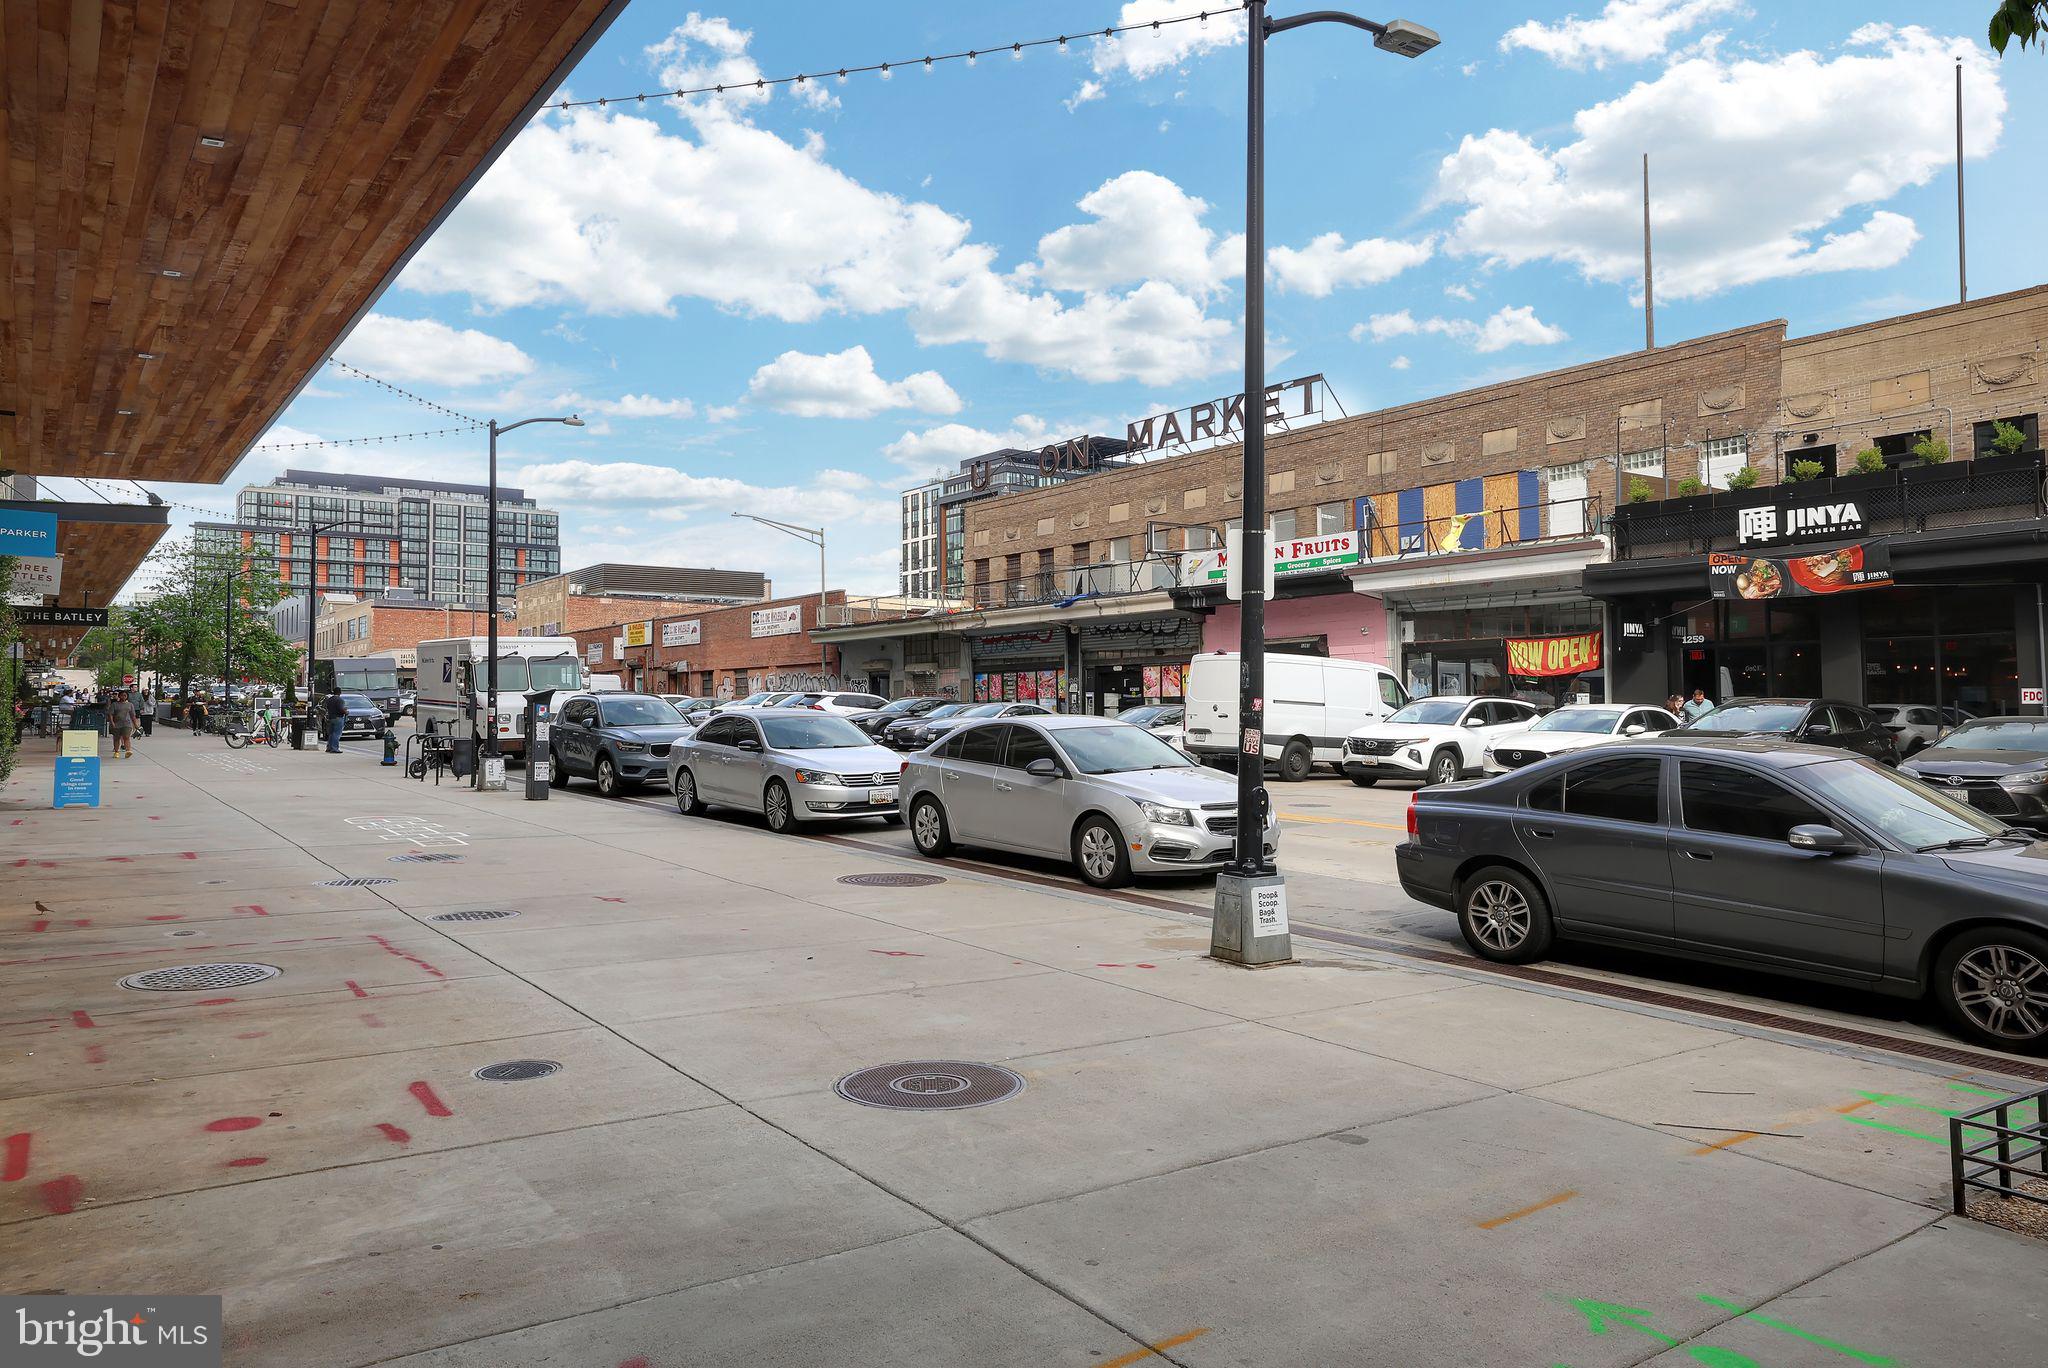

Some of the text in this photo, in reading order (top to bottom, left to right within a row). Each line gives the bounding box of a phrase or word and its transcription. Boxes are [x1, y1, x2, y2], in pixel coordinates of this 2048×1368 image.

[1127, 374, 1322, 451] MARKET
[1785, 503, 1861, 536] JINYA
[0, 528, 48, 539] PARKER
[1800, 526, 1836, 536] RAMEN
[1291, 538, 1350, 558] FRUITS
[1286, 557, 1342, 569] Grocery Spices
[1712, 555, 1742, 564] OPEN
[15, 563, 49, 573] HREE
[1711, 566, 1738, 575] NOW
[12, 571, 53, 582] TTLES
[1867, 571, 1889, 580] JINYA
[24, 611, 102, 622] THE BATLEY
[1623, 623, 1644, 637] JINYA
[1682, 635, 1705, 643] 1259
[1508, 641, 1543, 670] NOW
[2023, 691, 2042, 701] FDC
[1244, 743, 1259, 753] US
[1258, 891, 1278, 899] Poop&
[1259, 908, 1275, 917] Bag&
[1259, 916, 1277, 924] Trash.
